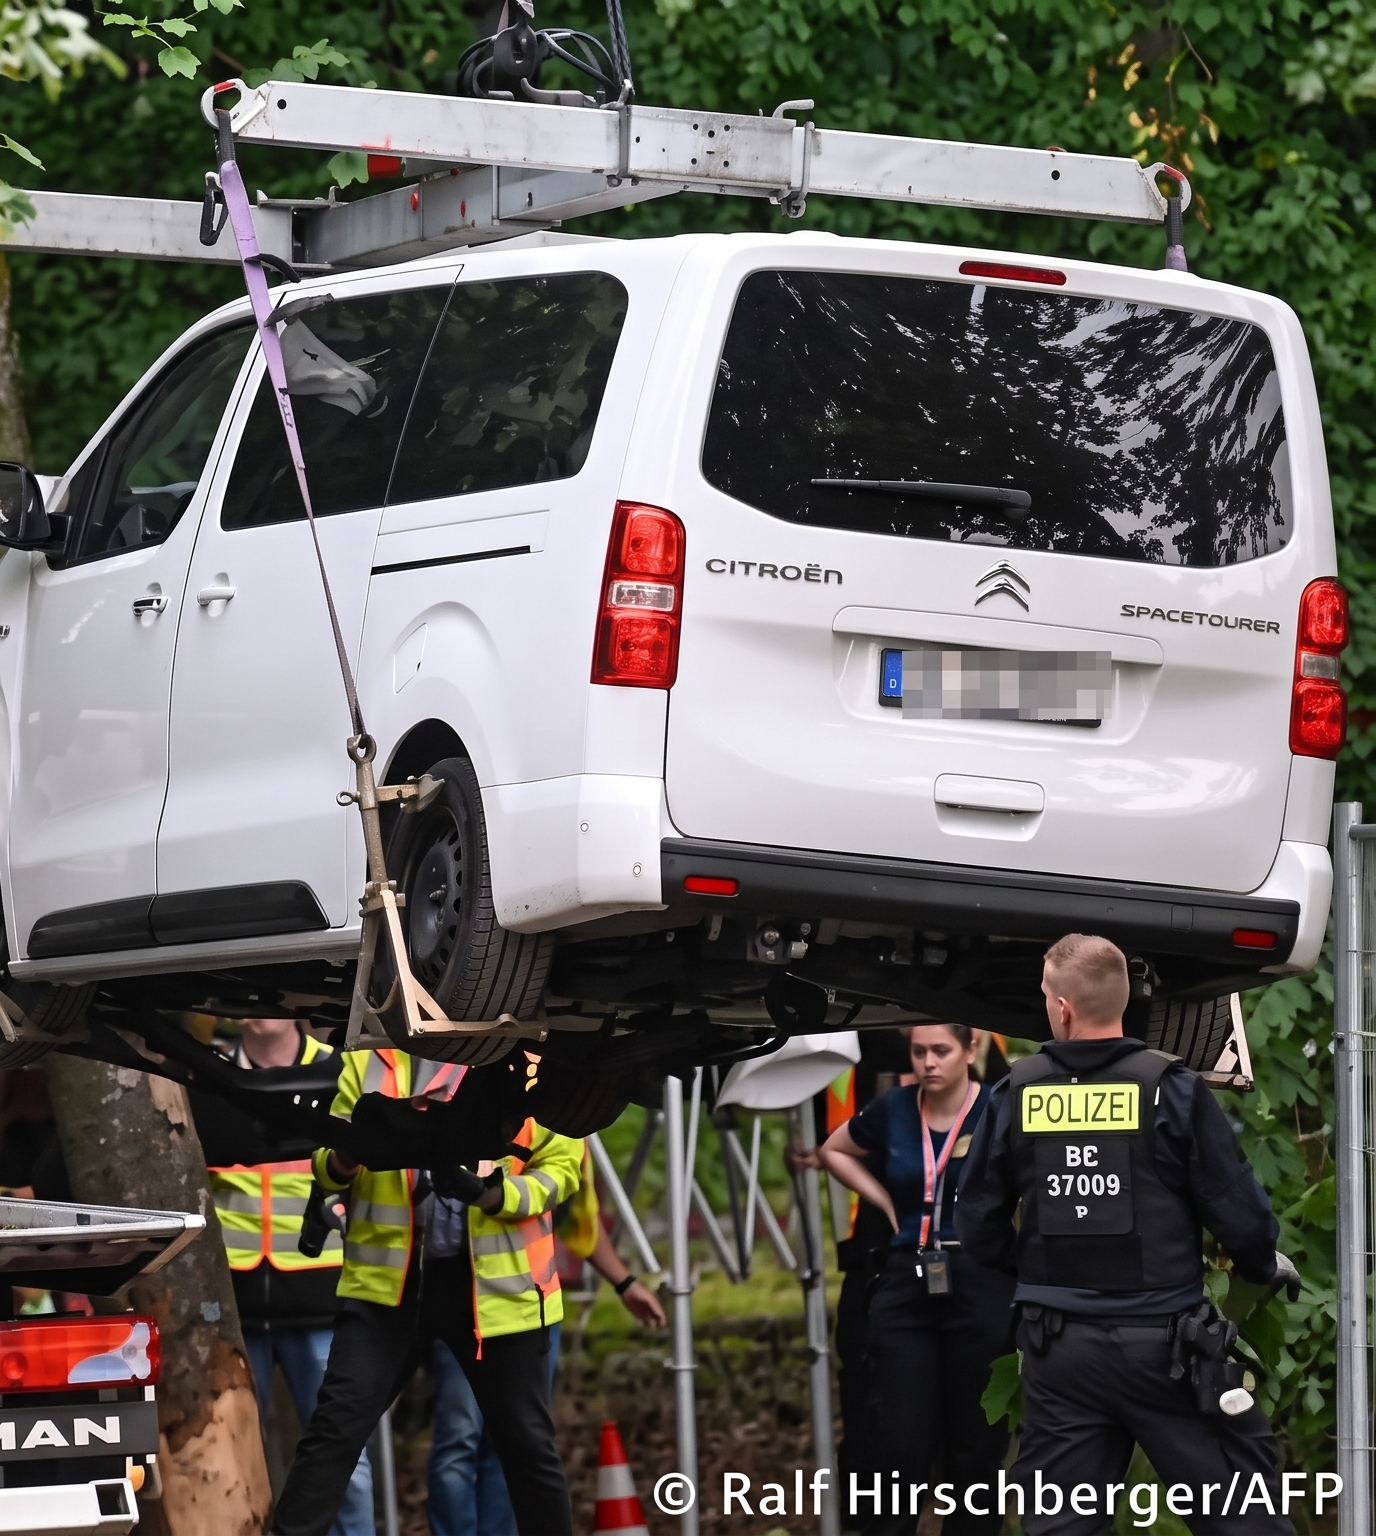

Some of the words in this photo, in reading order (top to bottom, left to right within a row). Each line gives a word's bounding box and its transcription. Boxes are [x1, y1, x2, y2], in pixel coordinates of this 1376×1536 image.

[1120, 603, 1281, 635] SPACETOURER
[888, 678, 897, 689] D
[1027, 1091, 1133, 1124] POLIZEI
[1065, 1145, 1099, 1167] BE
[1046, 1173, 1121, 1197] 37009
[1075, 1205, 1089, 1218] P
